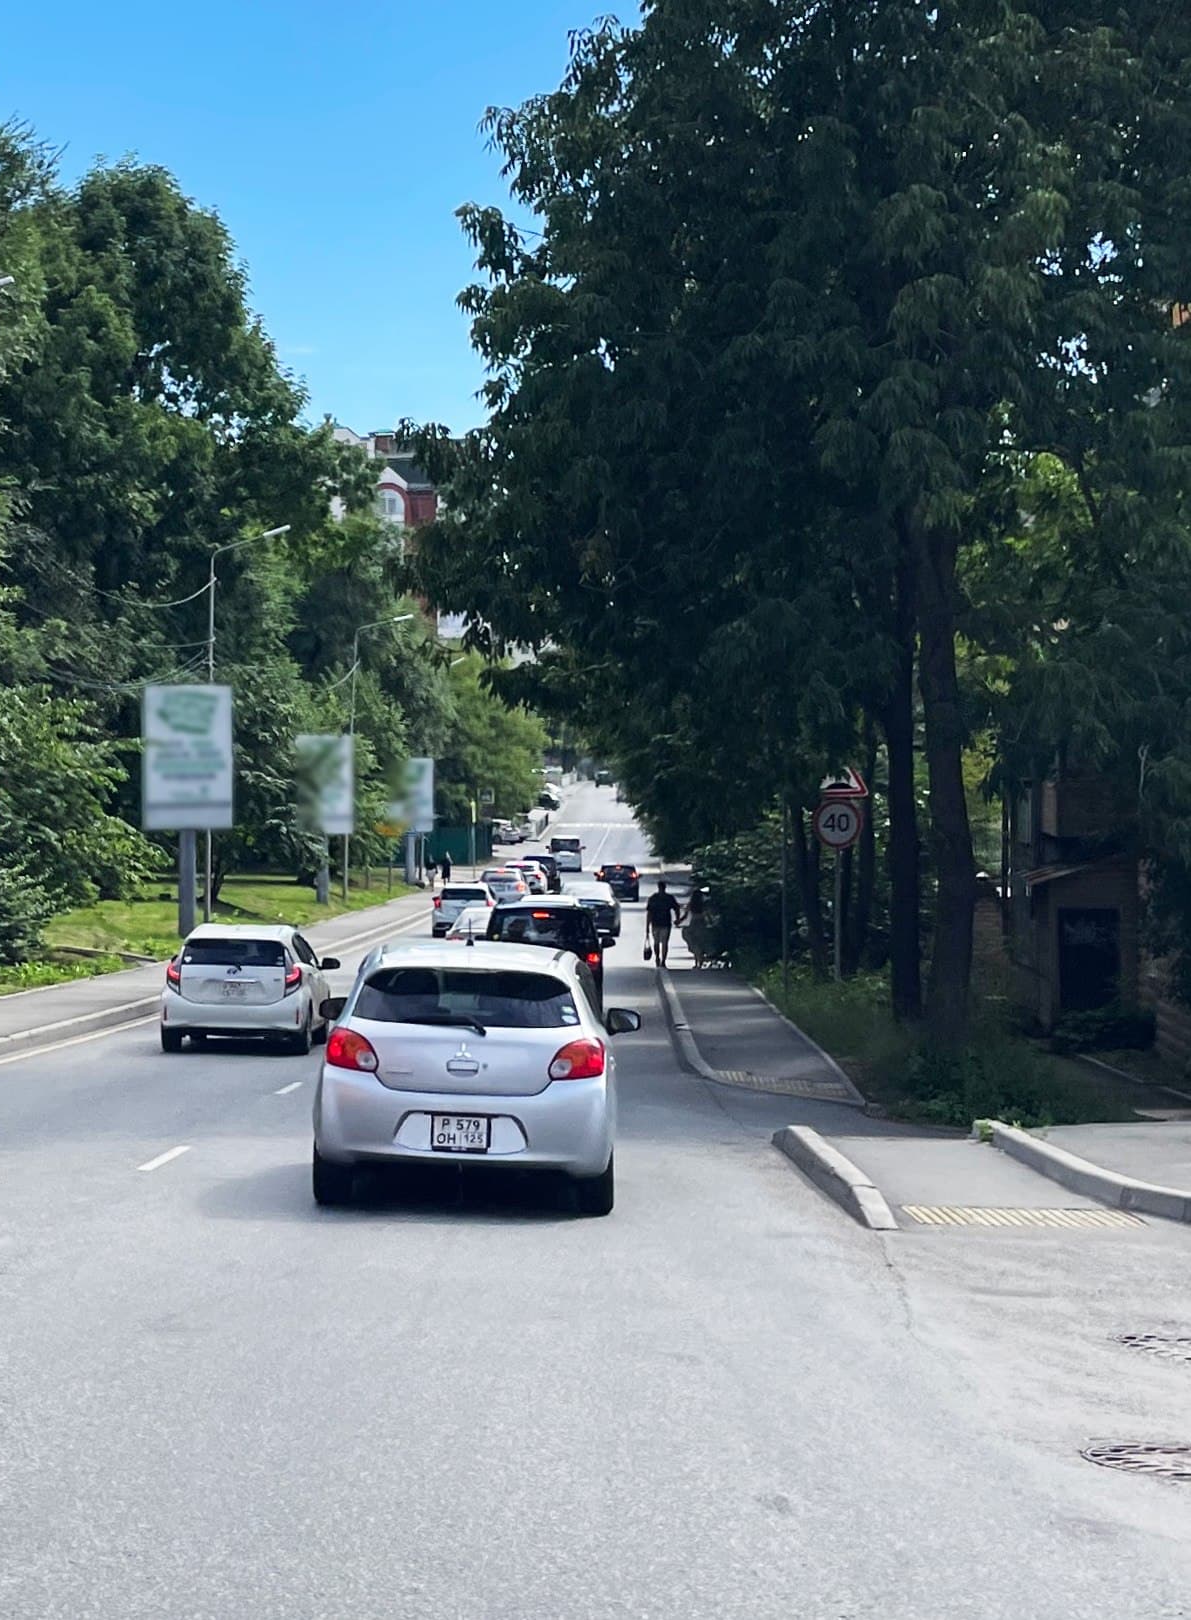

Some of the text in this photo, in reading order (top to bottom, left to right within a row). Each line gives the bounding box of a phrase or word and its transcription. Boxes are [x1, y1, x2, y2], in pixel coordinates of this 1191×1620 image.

[822, 814, 850, 833] 40
[456, 1119, 480, 1131] 579
[464, 1134, 484, 1144] 125
